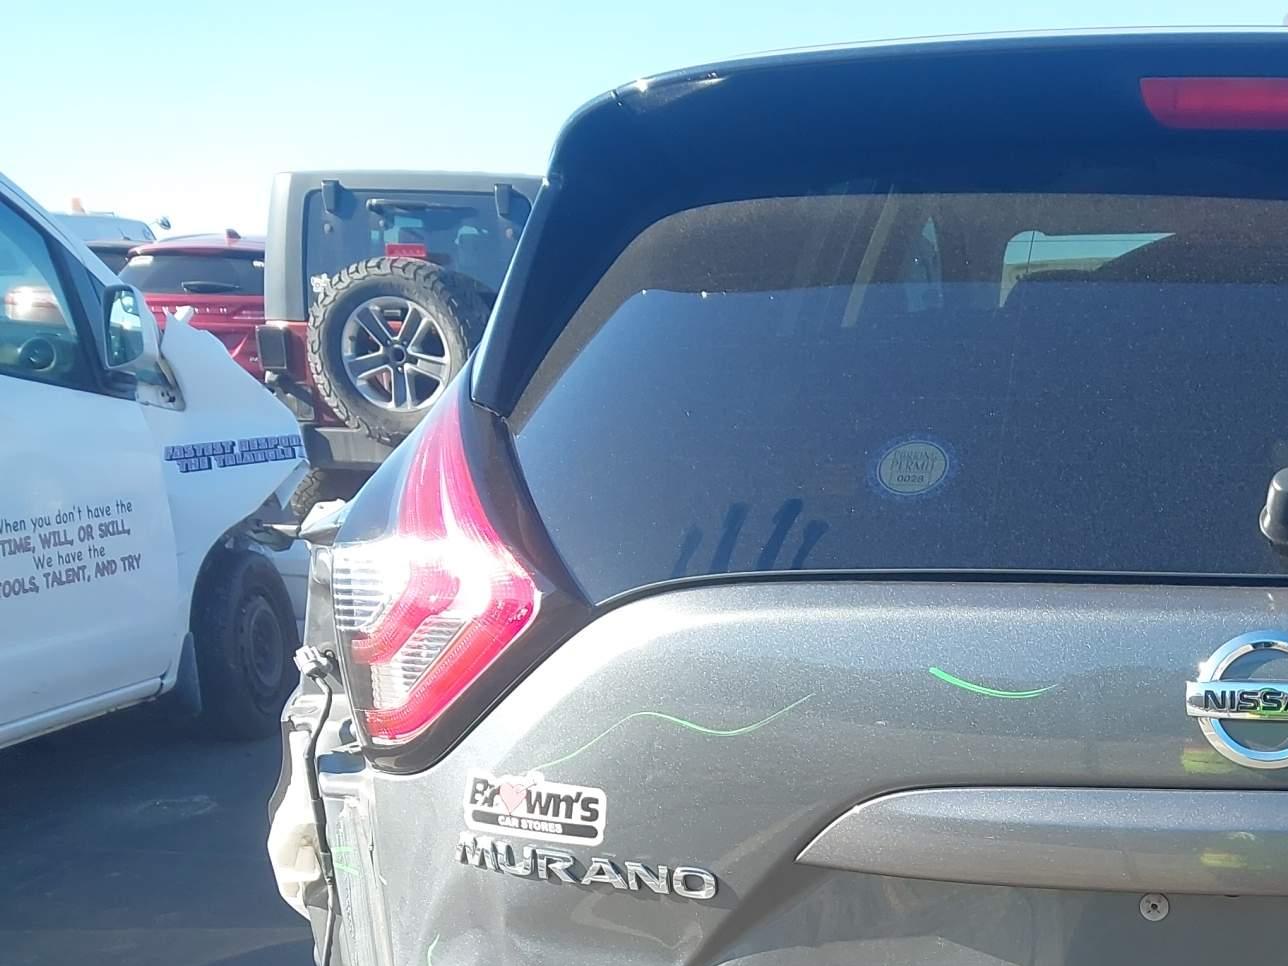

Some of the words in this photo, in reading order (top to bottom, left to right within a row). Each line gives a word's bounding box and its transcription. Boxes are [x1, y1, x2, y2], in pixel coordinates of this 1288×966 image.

[177, 457, 212, 473] THE
[214, 447, 296, 468] TRIANGLE
[30, 514, 51, 533] you
[55, 505, 82, 525] don't
[86, 504, 111, 519] have
[115, 499, 132, 514] the
[0, 535, 36, 557] TIME,
[39, 529, 74, 550] WILL,
[78, 524, 94, 543] OR
[98, 519, 131, 538] SKILL,
[33, 553, 53, 570] We
[57, 550, 83, 566] have
[88, 545, 105, 559] the
[0, 575, 39, 598] OOLS,
[43, 565, 91, 589] TALENT,
[95, 559, 118, 578] AND
[120, 553, 141, 572] TRY
[498, 815, 519, 828] CAR
[520, 818, 563, 834] STORES
[456, 832, 718, 900] MURANO
